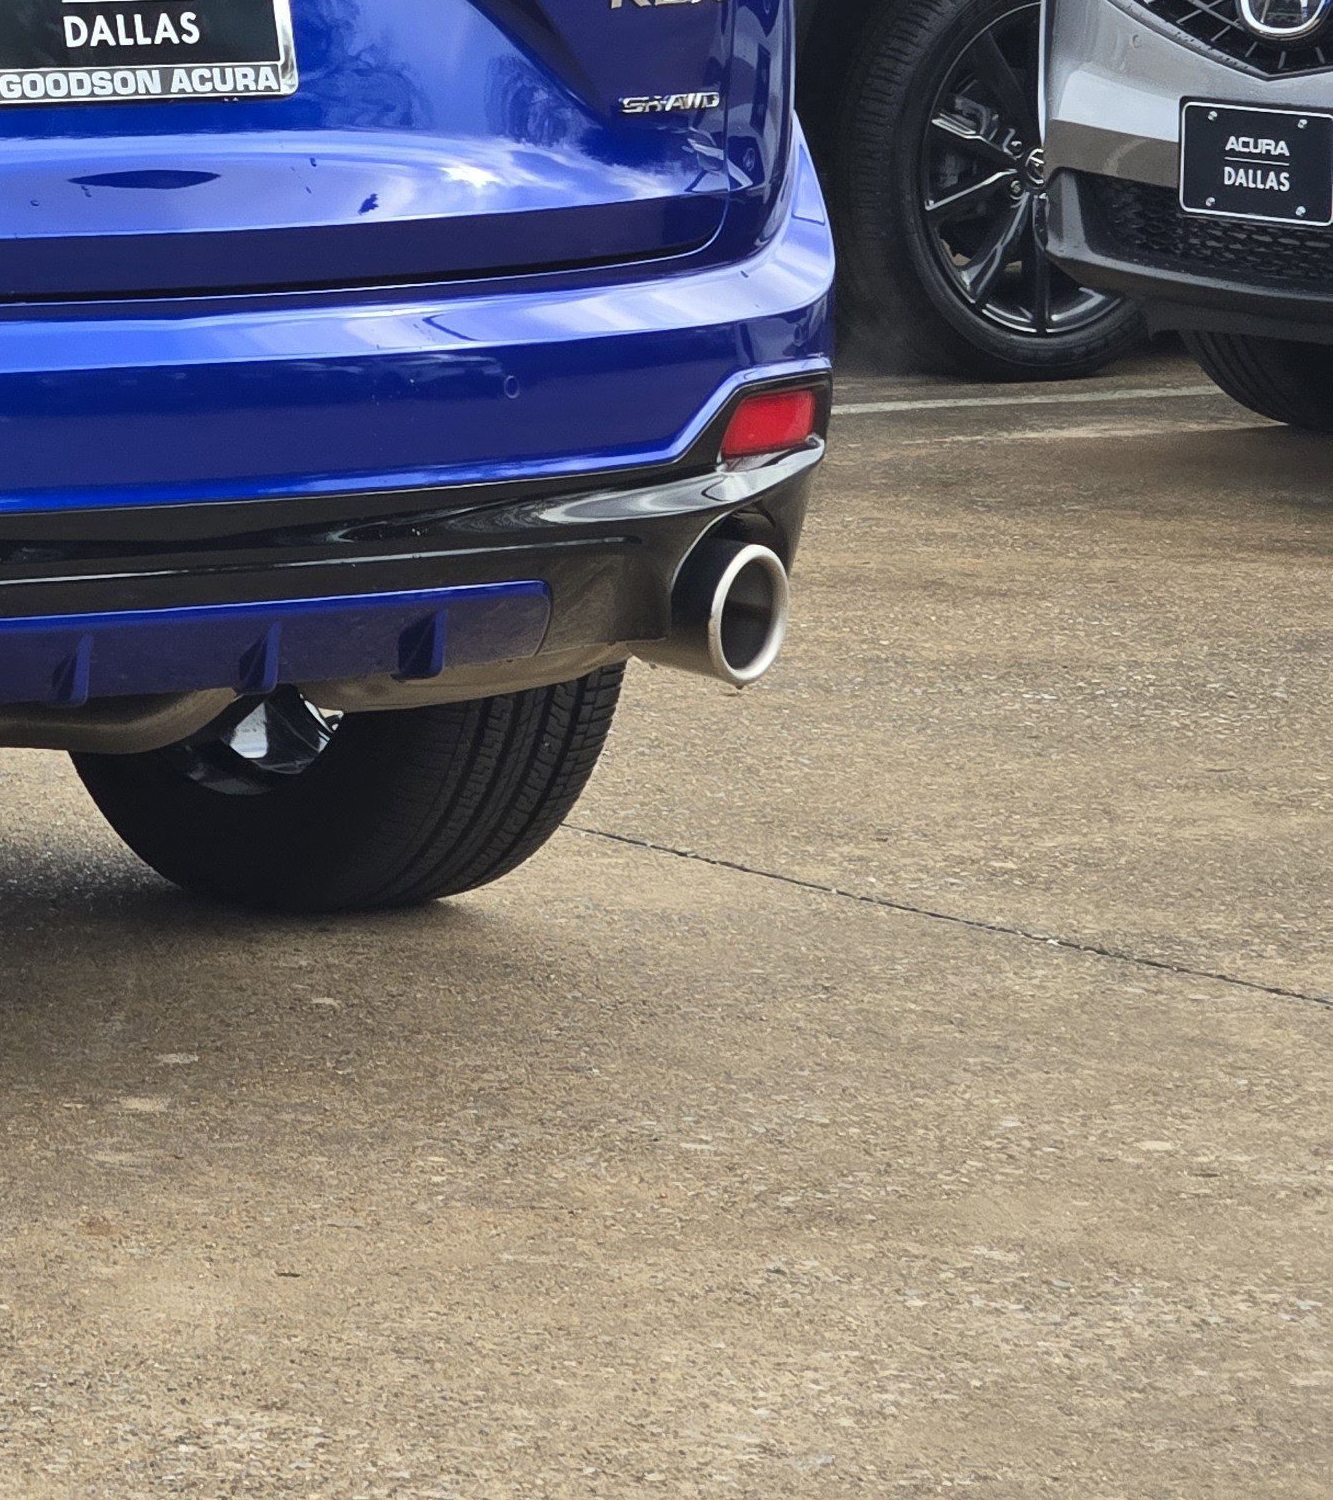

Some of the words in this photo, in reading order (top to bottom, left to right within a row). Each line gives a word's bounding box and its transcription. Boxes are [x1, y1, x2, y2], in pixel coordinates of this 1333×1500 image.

[62, 11, 200, 48] DALLAS
[0, 70, 161, 99] GOODSON
[170, 66, 280, 93] ACURA
[1225, 135, 1290, 157] ACURA
[1223, 166, 1290, 192] DALLAS
